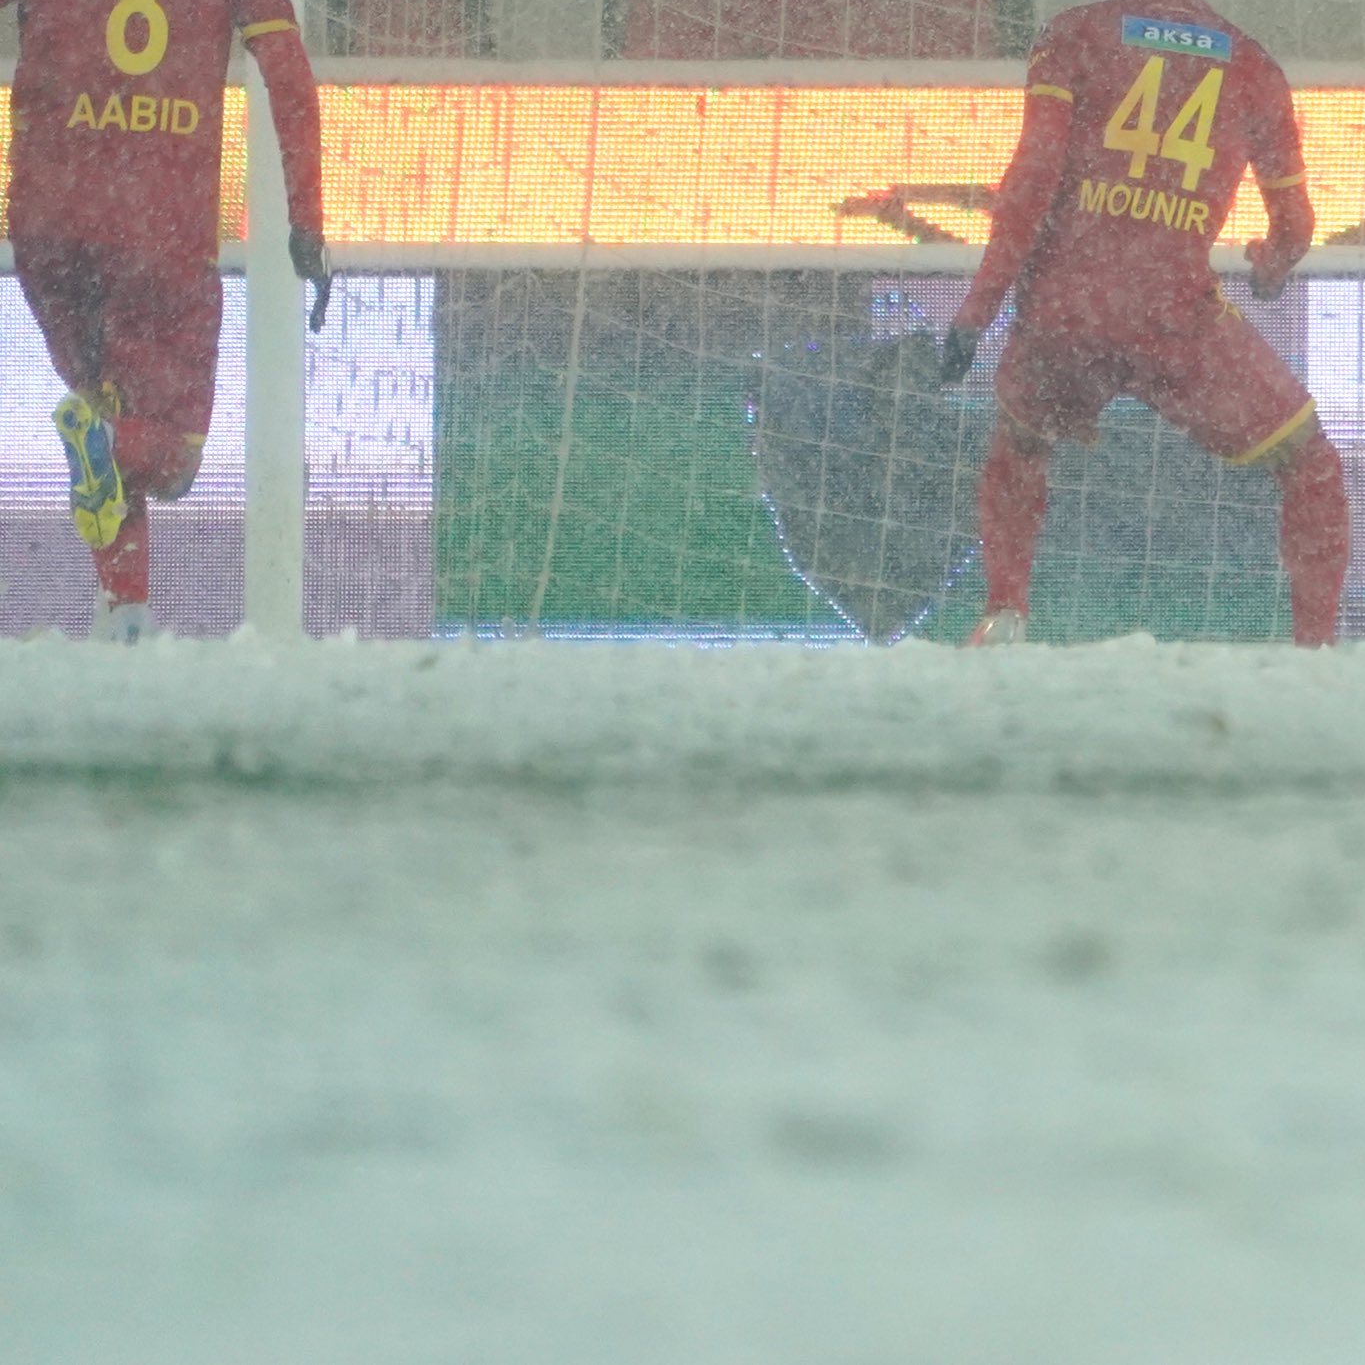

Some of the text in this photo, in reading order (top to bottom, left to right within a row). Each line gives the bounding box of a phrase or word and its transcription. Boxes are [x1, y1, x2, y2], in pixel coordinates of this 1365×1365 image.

[1144, 23, 1215, 50] aksa
[66, 93, 200, 135] AABID
[1103, 55, 1225, 192] 44
[1078, 178, 1211, 235] MOUNIR
